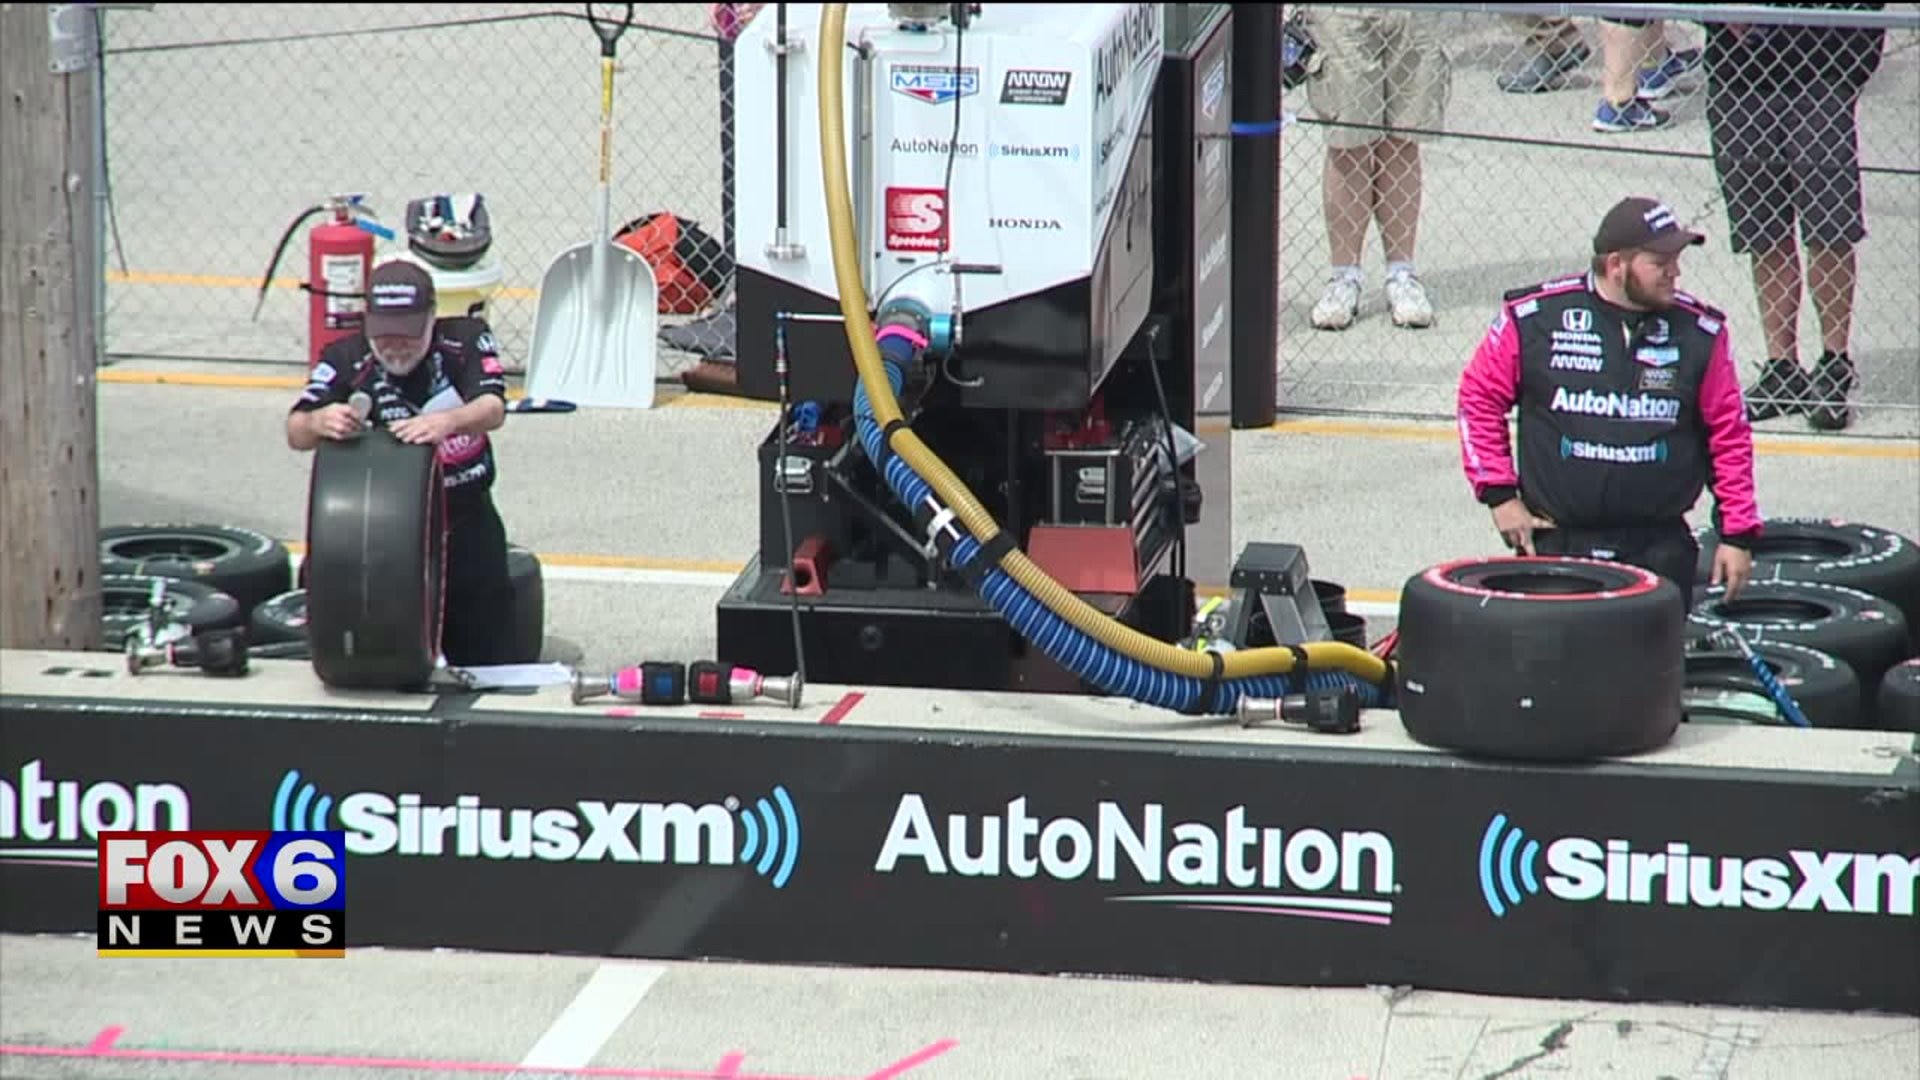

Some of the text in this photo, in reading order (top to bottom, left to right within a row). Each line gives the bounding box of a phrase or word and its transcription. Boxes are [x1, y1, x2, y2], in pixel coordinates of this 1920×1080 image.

[895, 74, 974, 88] MSR
[989, 218, 1062, 230] HONDA
[1552, 331, 1602, 344] HONDA
[1550, 386, 1680, 418] AutoNation
[875, 793, 1394, 894] AutoNation
